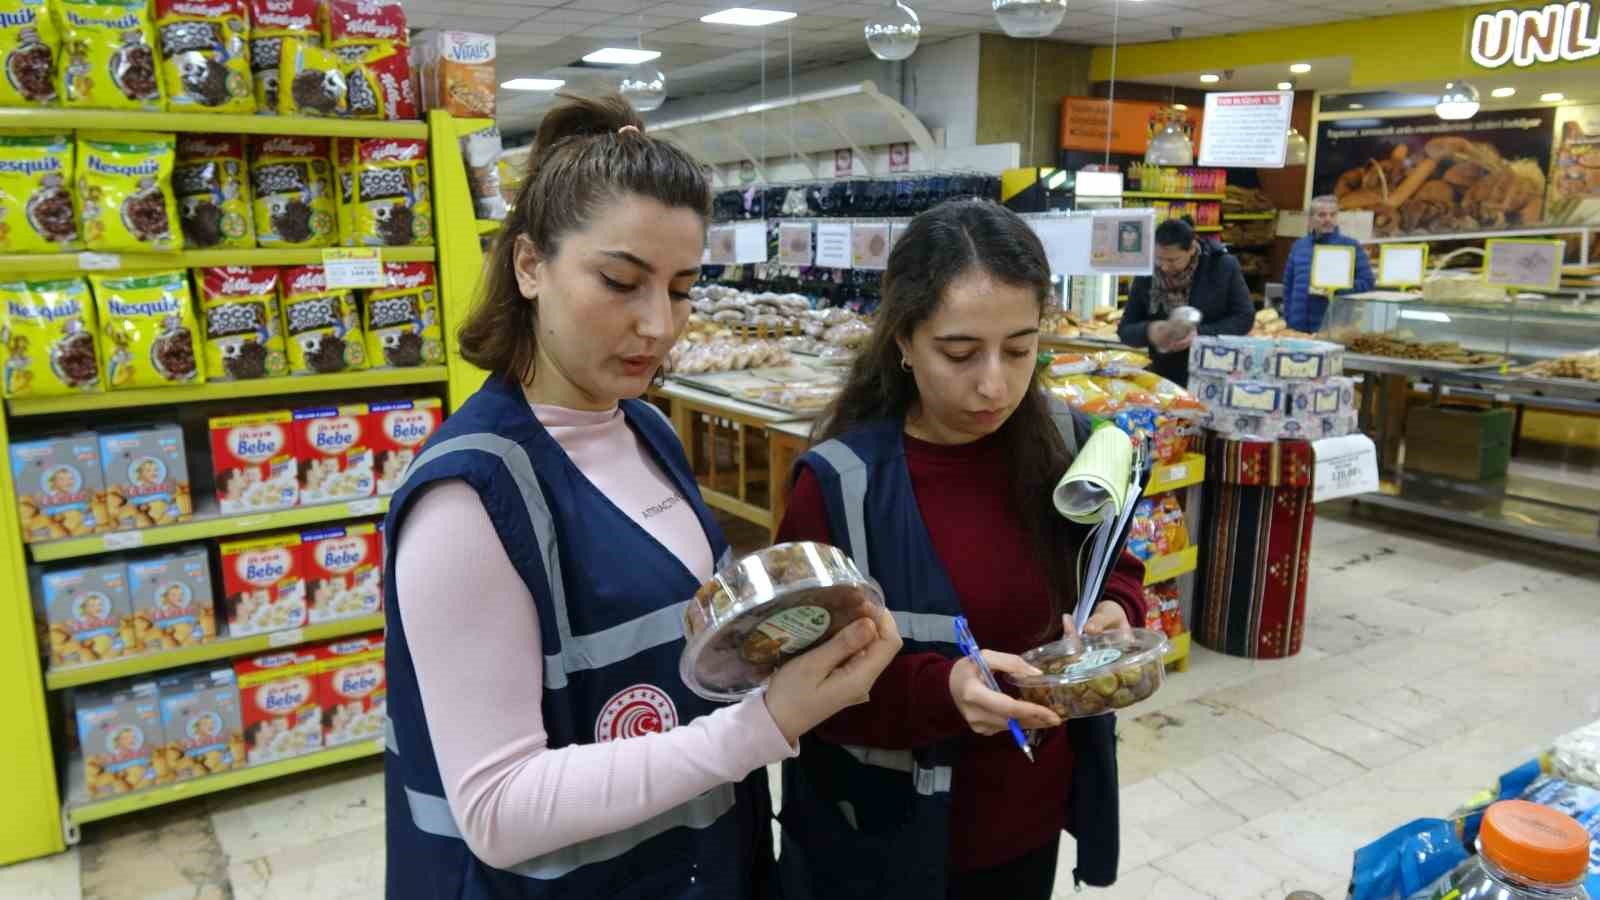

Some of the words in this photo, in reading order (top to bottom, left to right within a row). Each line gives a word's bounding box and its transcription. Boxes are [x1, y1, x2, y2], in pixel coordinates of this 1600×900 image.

[1471, 1, 1600, 68] UNL
[87, 154, 160, 176] Nesquik
[362, 172, 402, 187] COCO
[109, 296, 180, 318] Nesquik
[392, 423, 427, 439] Bebe
[238, 439, 275, 455] Bebe
[316, 432, 353, 448] Bebe
[324, 551, 360, 567] Bebe
[246, 563, 283, 580] Bebe
[342, 677, 377, 692] Bebe
[265, 693, 303, 710] Bebe
